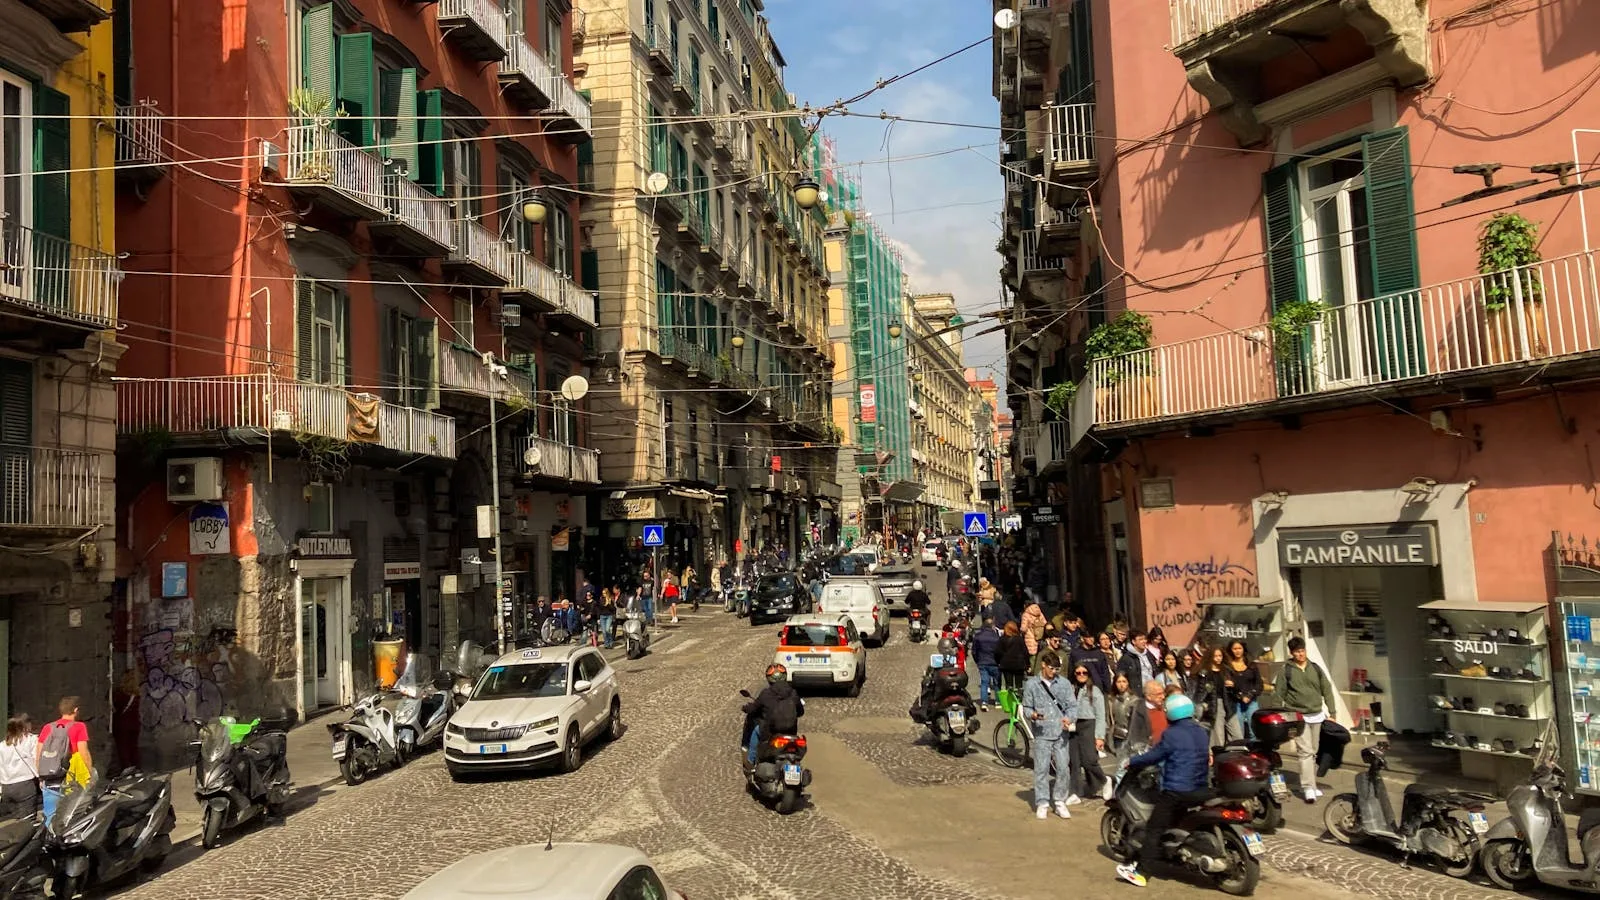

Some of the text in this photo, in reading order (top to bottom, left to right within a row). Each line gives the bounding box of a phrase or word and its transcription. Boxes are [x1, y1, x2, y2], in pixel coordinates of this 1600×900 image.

[1032, 513, 1061, 522] Tessere
[300, 538, 352, 556] OUTLETMANIA
[1286, 544, 1424, 565] CAMPANILE
[1218, 626, 1248, 639] SALDI
[523, 650, 540, 658] TAXI
[1454, 639, 1499, 655] SALDI
